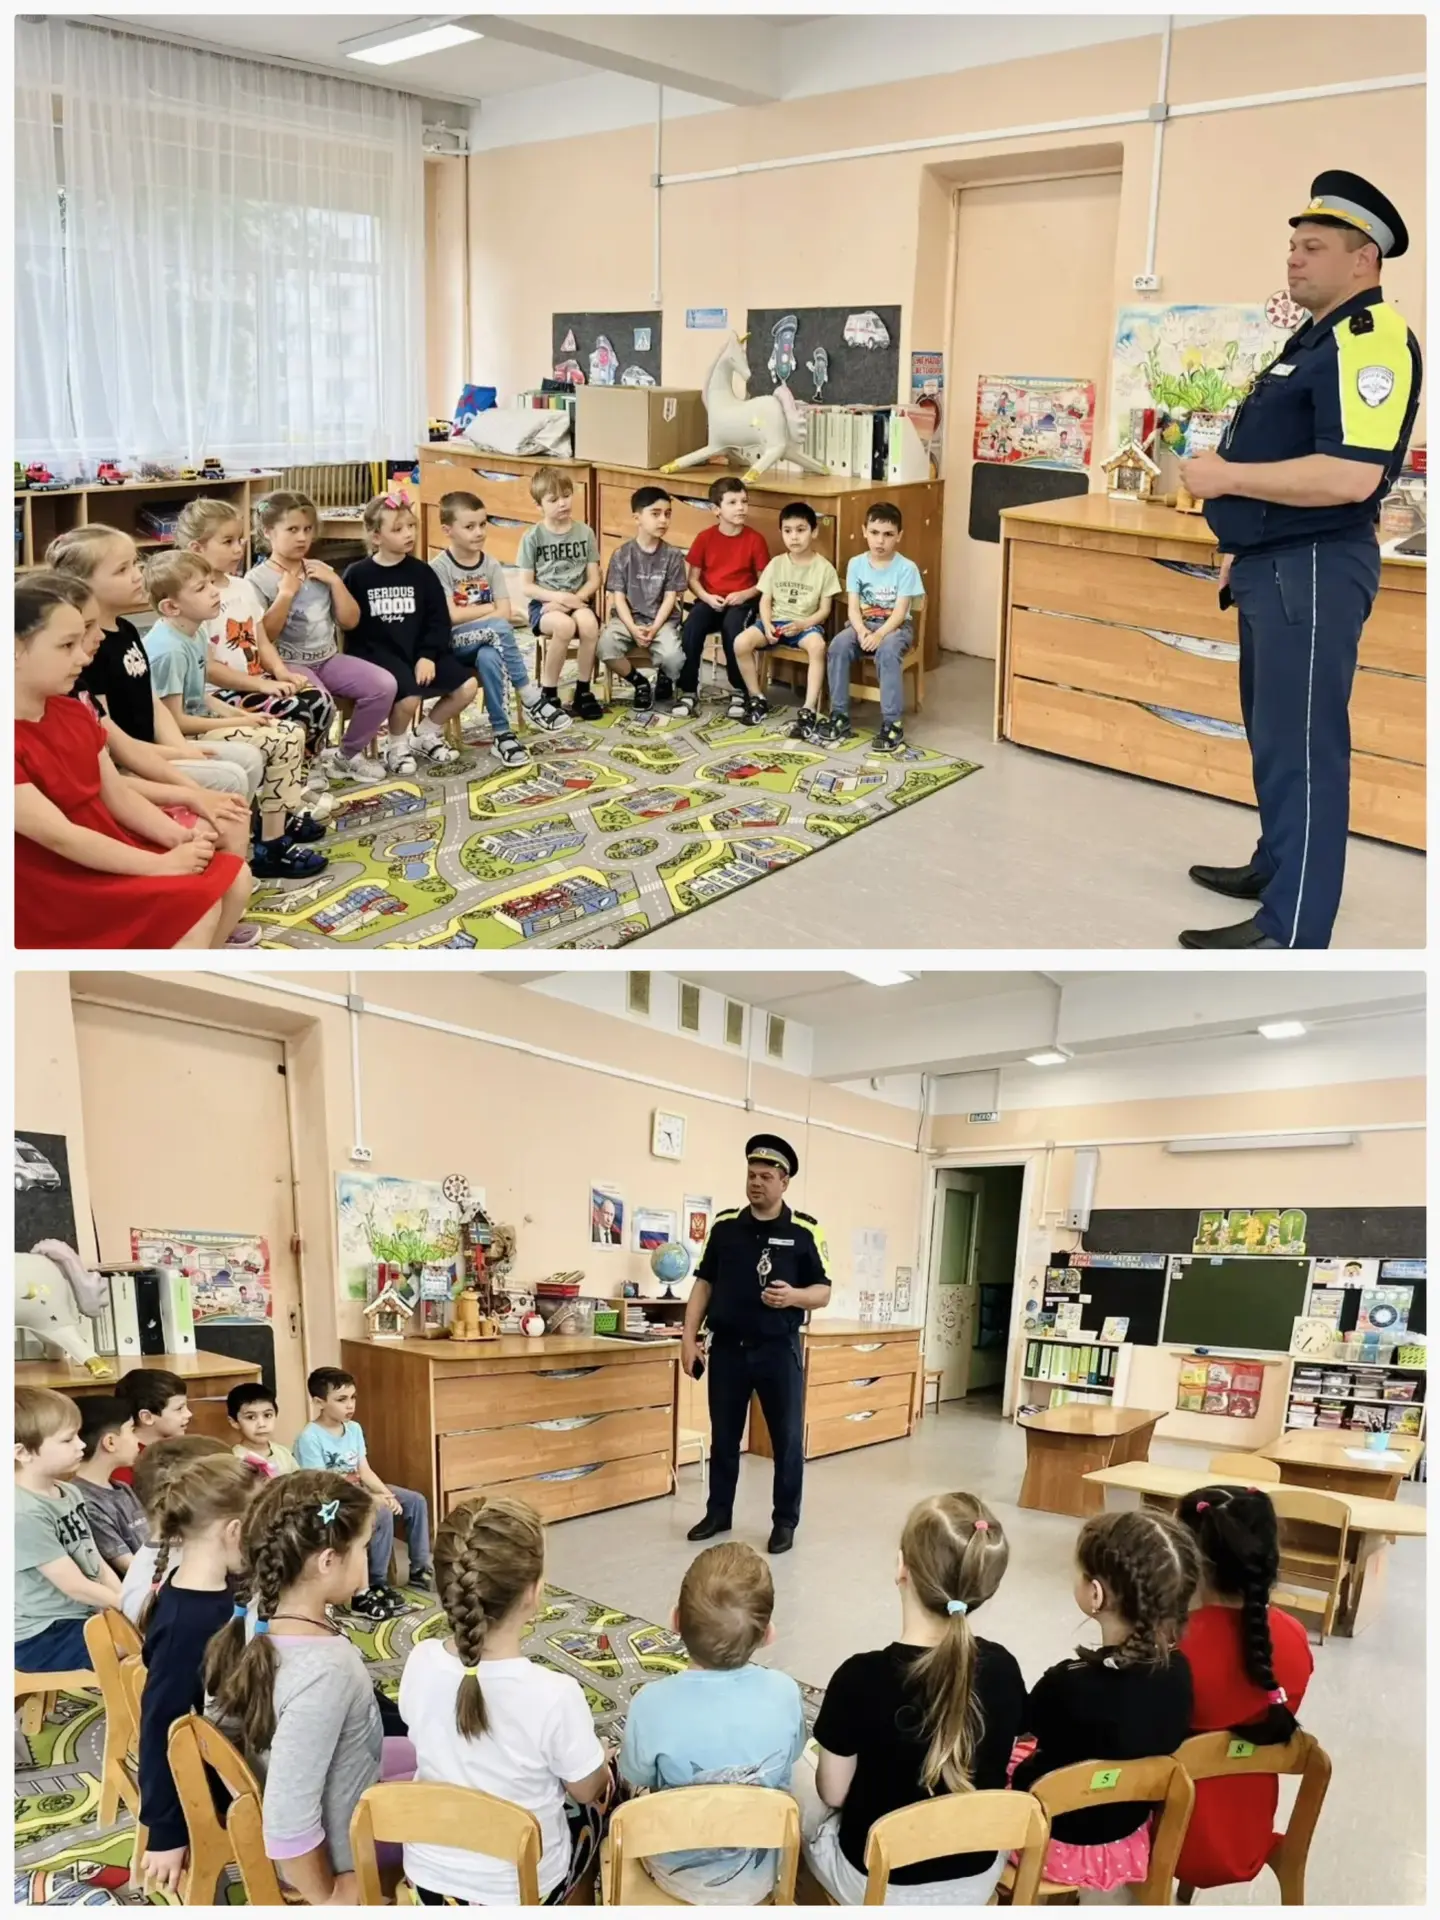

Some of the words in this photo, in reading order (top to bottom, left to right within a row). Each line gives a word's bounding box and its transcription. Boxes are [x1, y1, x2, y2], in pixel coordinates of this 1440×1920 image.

[536, 540, 587, 562] PERFECT
[367, 586, 415, 600] SERIOUS
[368, 597, 416, 617] MOOD
[1235, 1743, 1244, 1754] 8
[1101, 1772, 1110, 1784] 5
